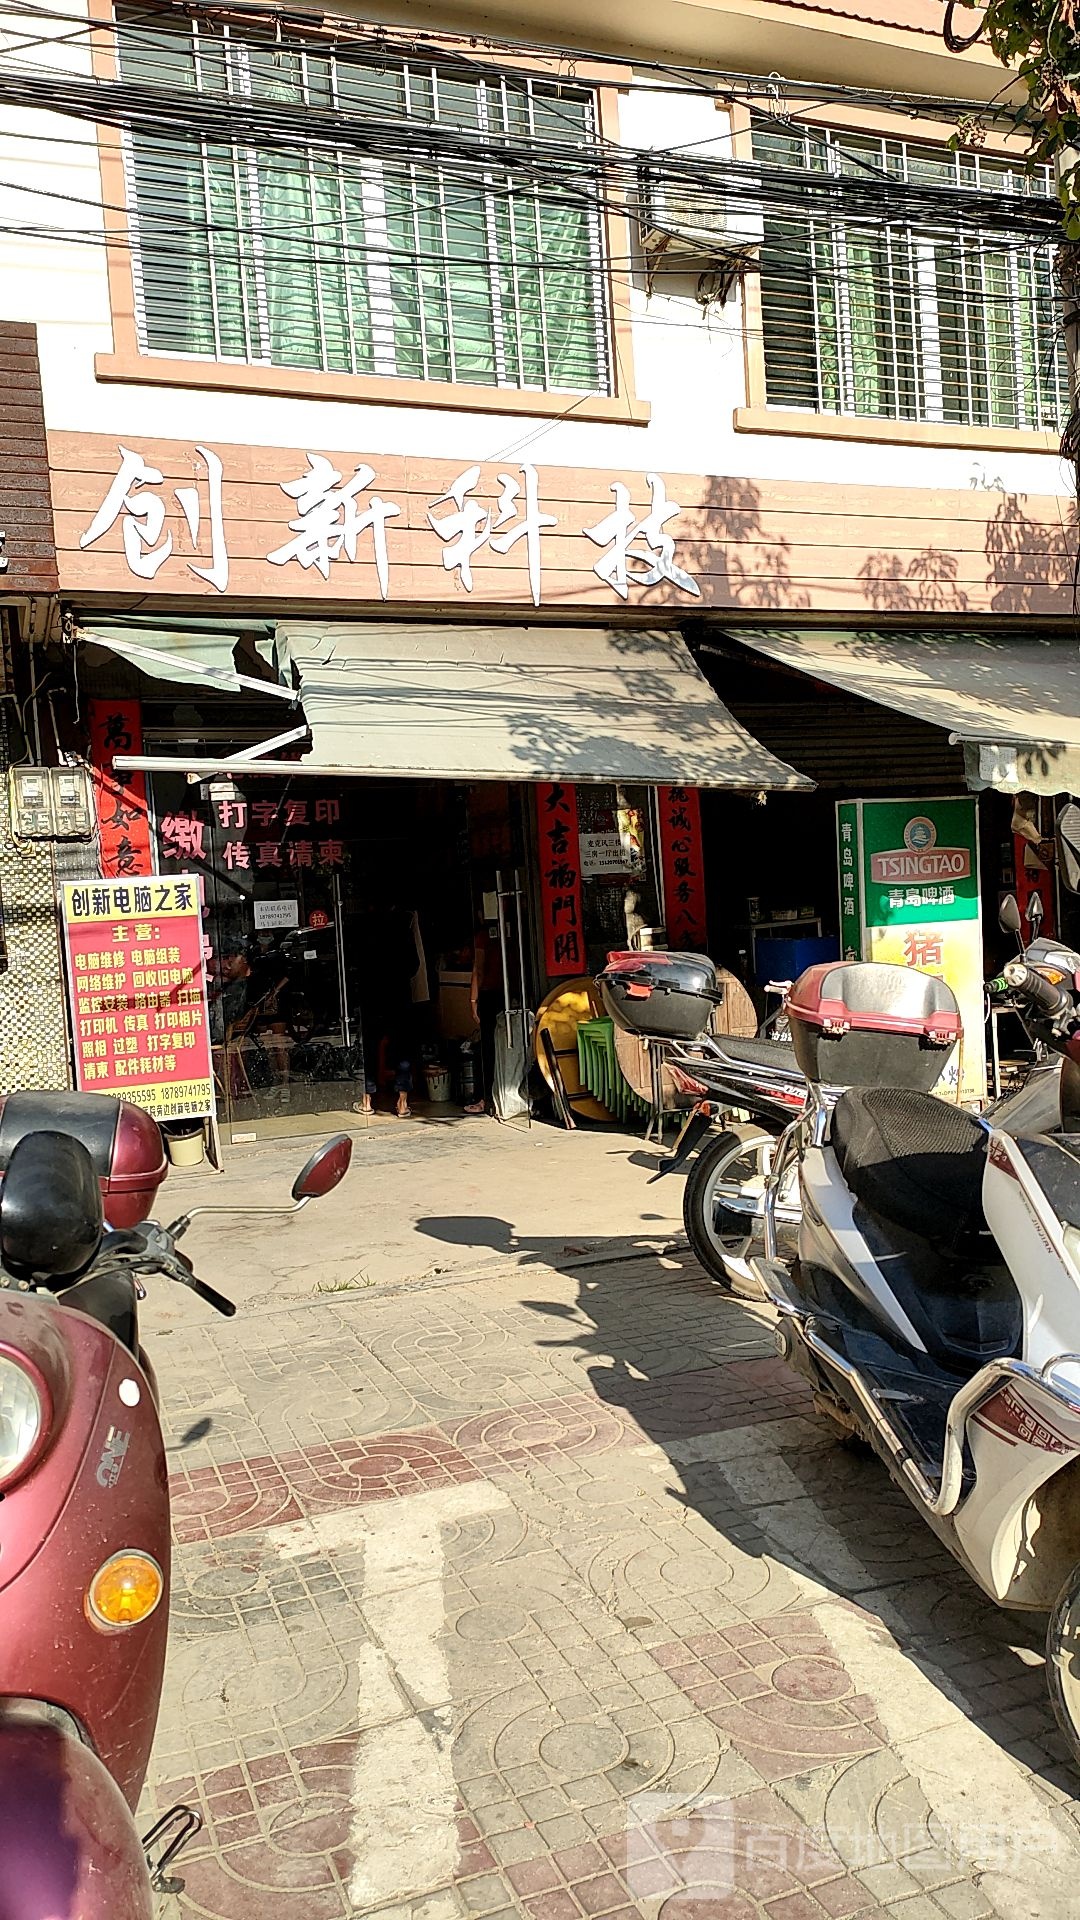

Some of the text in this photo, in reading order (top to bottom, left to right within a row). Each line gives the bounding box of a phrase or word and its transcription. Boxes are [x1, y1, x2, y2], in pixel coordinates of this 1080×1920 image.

[79, 444, 701, 606] 创新科技
[218, 798, 341, 829] 打字复印
[876, 852, 965, 877] TSINGTAO
[71, 883, 193, 917] 创新电脑之家
[887, 885, 955, 909] 青岛啤酒
[311, 913, 326, 927] 拉
[74, 948, 181, 971] 电脑维修 电脑组装
[903, 931, 944, 966] 猪
[76, 967, 194, 993] 网络维护 回收旧电脑
[78, 988, 202, 1015] 监控安装 路由器 扫描
[79, 1009, 203, 1037] 打印机 传真 打印相片
[82, 1031, 196, 1058] 照相 过塑 打字复印
[115, 1054, 177, 1077] 配件耗材等
[161, 1082, 211, 1100] 18789741795
